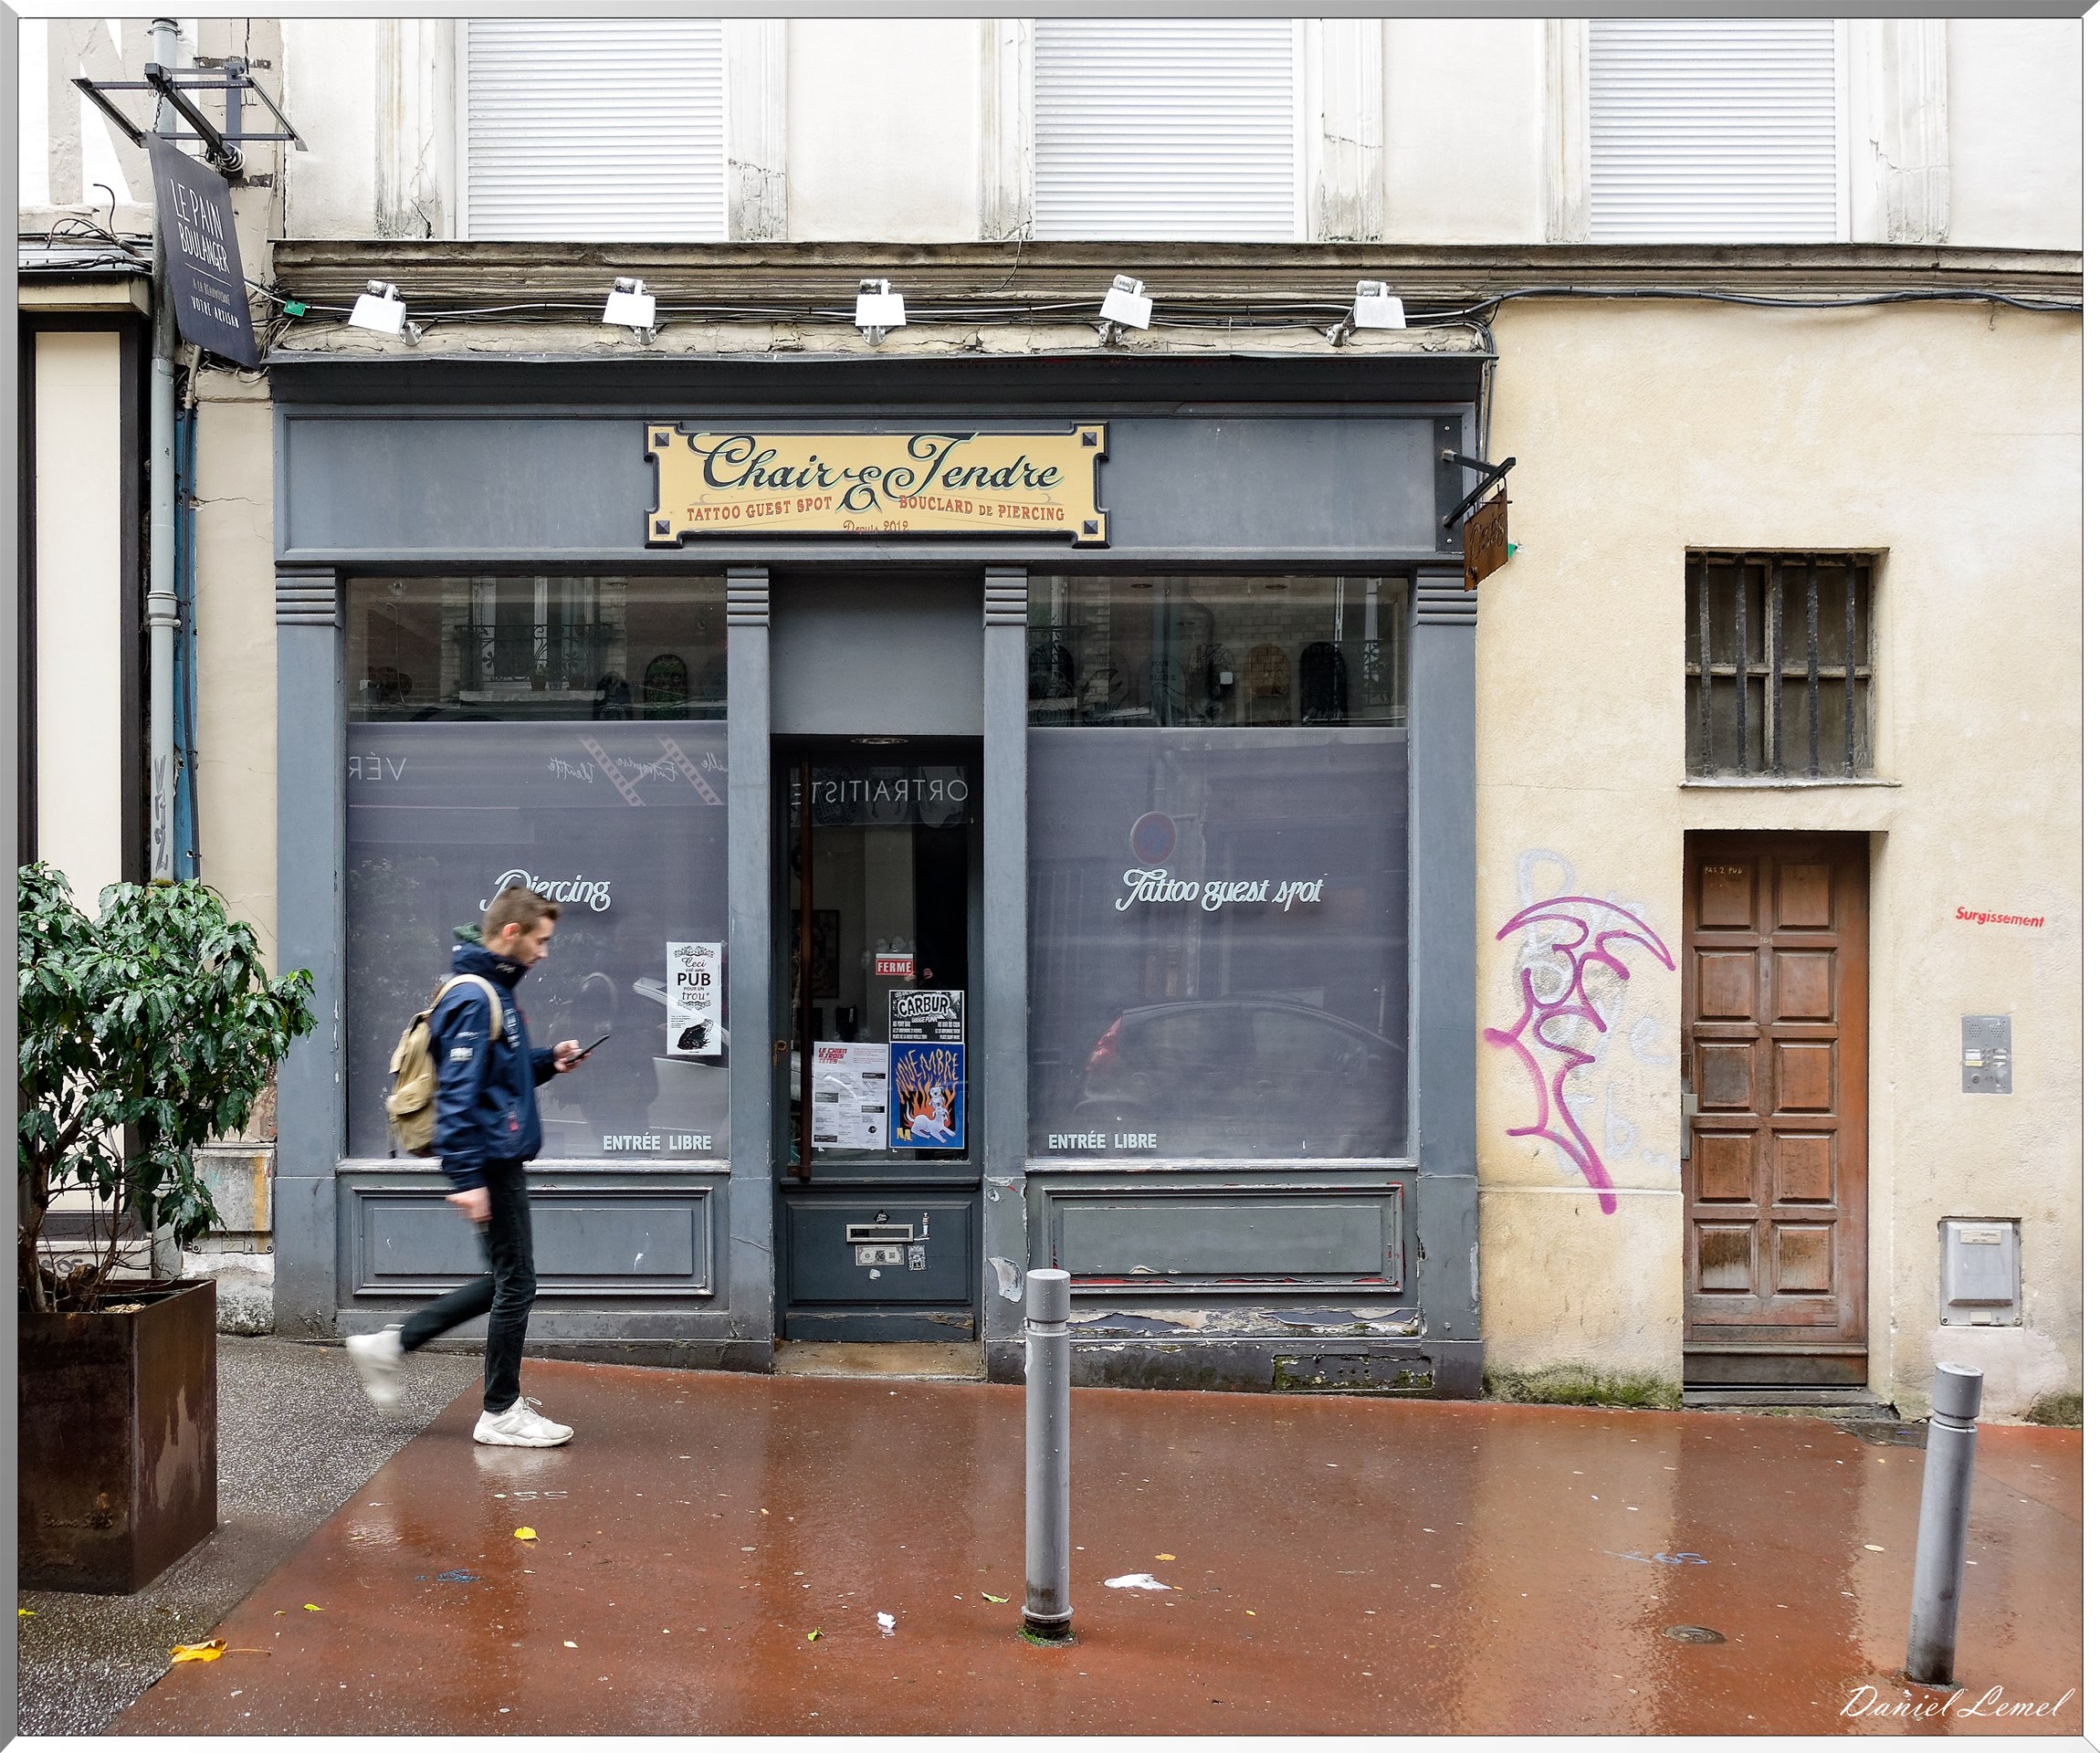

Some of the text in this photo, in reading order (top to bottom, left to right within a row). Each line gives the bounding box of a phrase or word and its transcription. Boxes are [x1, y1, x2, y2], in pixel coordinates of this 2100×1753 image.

[170, 178, 225, 241] LE PAIN
[177, 221, 231, 274] BOULANGER
[190, 294, 241, 330] VOTRE ARTISAN
[687, 432, 844, 490] Chair
[882, 432, 1066, 500] Tendre
[687, 505, 741, 522] TATTOO
[745, 500, 793, 520] GUEST
[796, 496, 833, 513] SPOT
[898, 494, 974, 515] BOUCLARD
[998, 503, 1066, 522] PIERCING
[843, 520, 910, 535] Depuis 2012
[1719, 866, 1725, 875] 2
[479, 868, 613, 913] Piercing
[1115, 867, 1325, 913] Tattoo guest spot
[1955, 906, 2045, 929] Surgissement
[682, 956, 708, 968] Ceci
[877, 960, 912, 974] FERMÉ
[677, 972, 712, 986] PUB
[898, 994, 950, 1016] CARBUR
[604, 1132, 712, 1150] ENTRÉE LIBRE
[1048, 1130, 1158, 1150] ENTRÉE LIBRE
